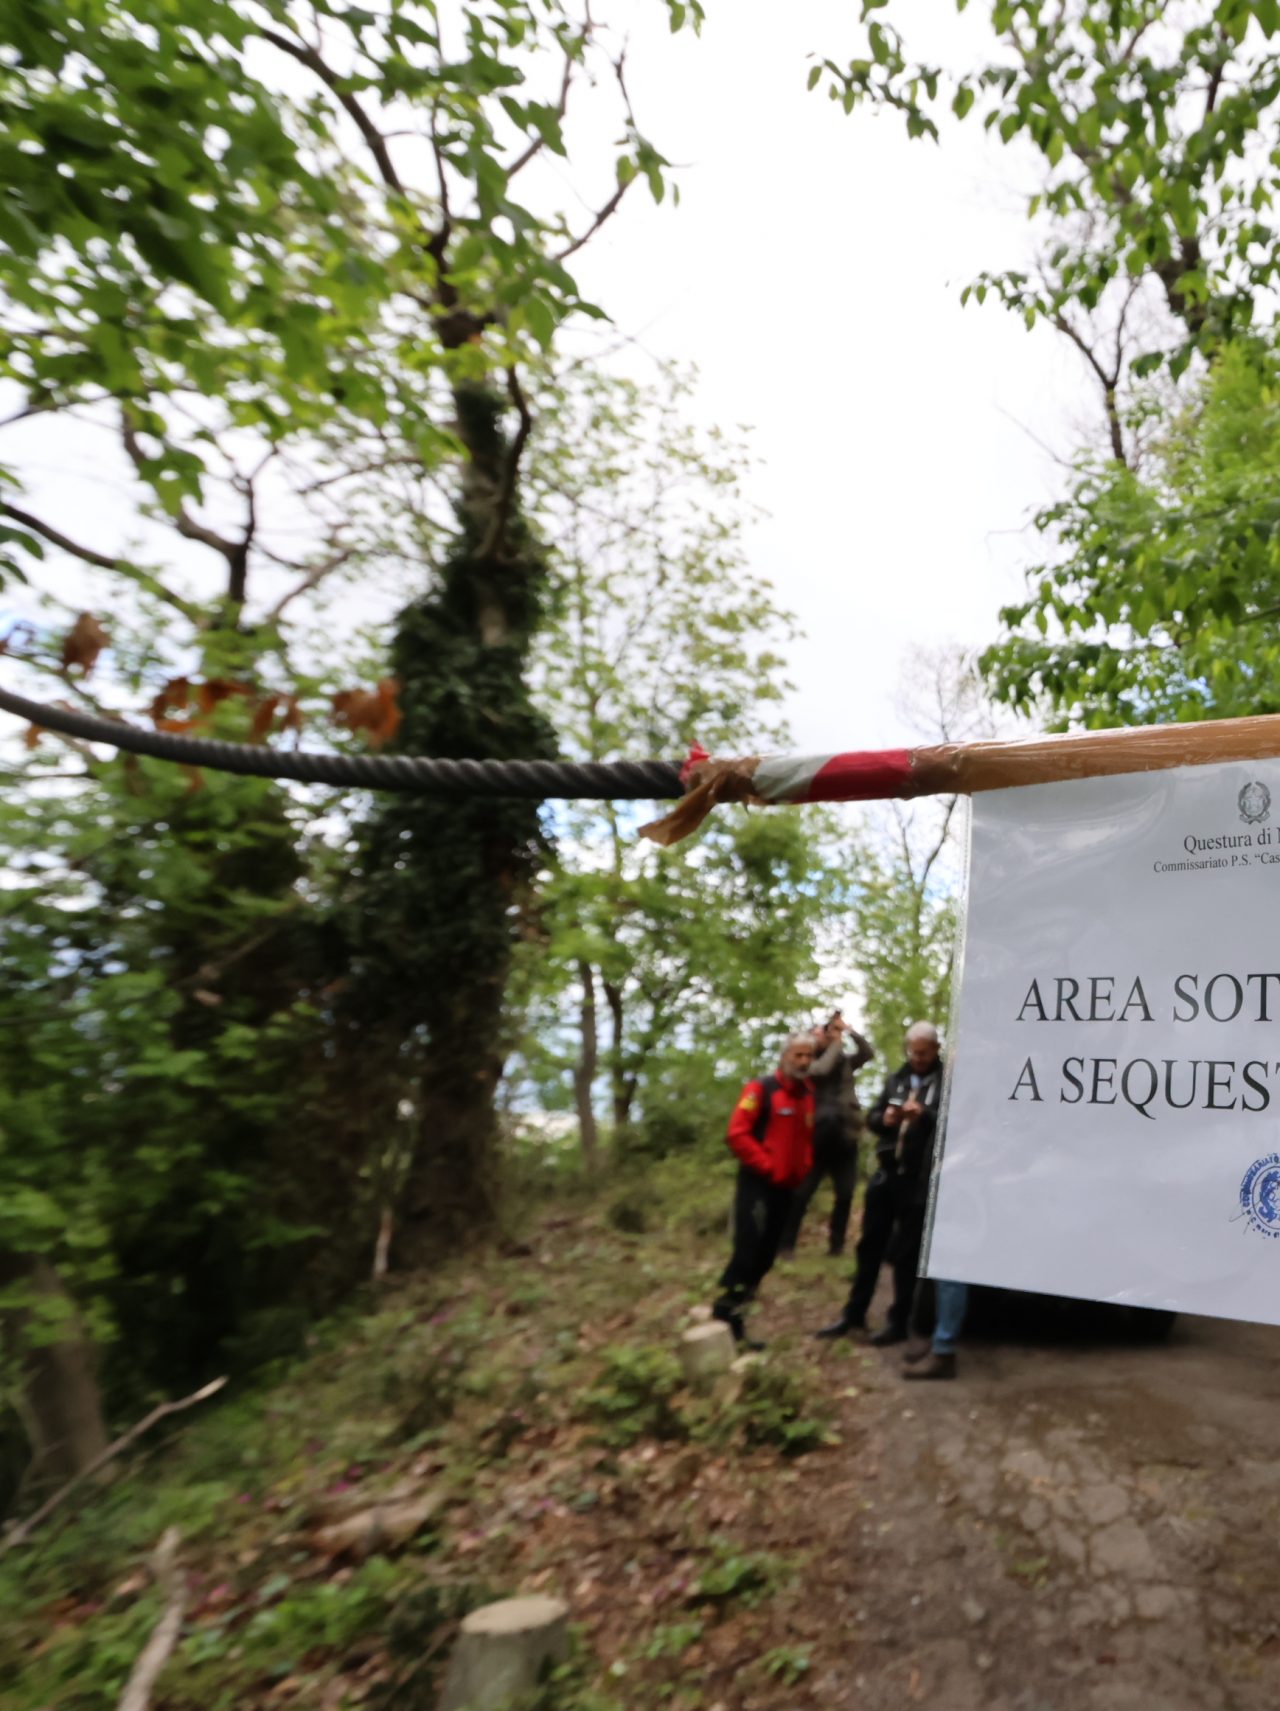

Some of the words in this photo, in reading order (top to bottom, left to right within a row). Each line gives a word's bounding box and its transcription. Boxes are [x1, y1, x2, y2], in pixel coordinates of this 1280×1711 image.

[1183, 832, 1253, 854] Questura
[1257, 829, 1272, 846] di
[1153, 855, 1229, 873] Commissariato
[1231, 854, 1252, 868] P.S.
[1015, 975, 1156, 1023] AREA
[1008, 1056, 1045, 1102] A
